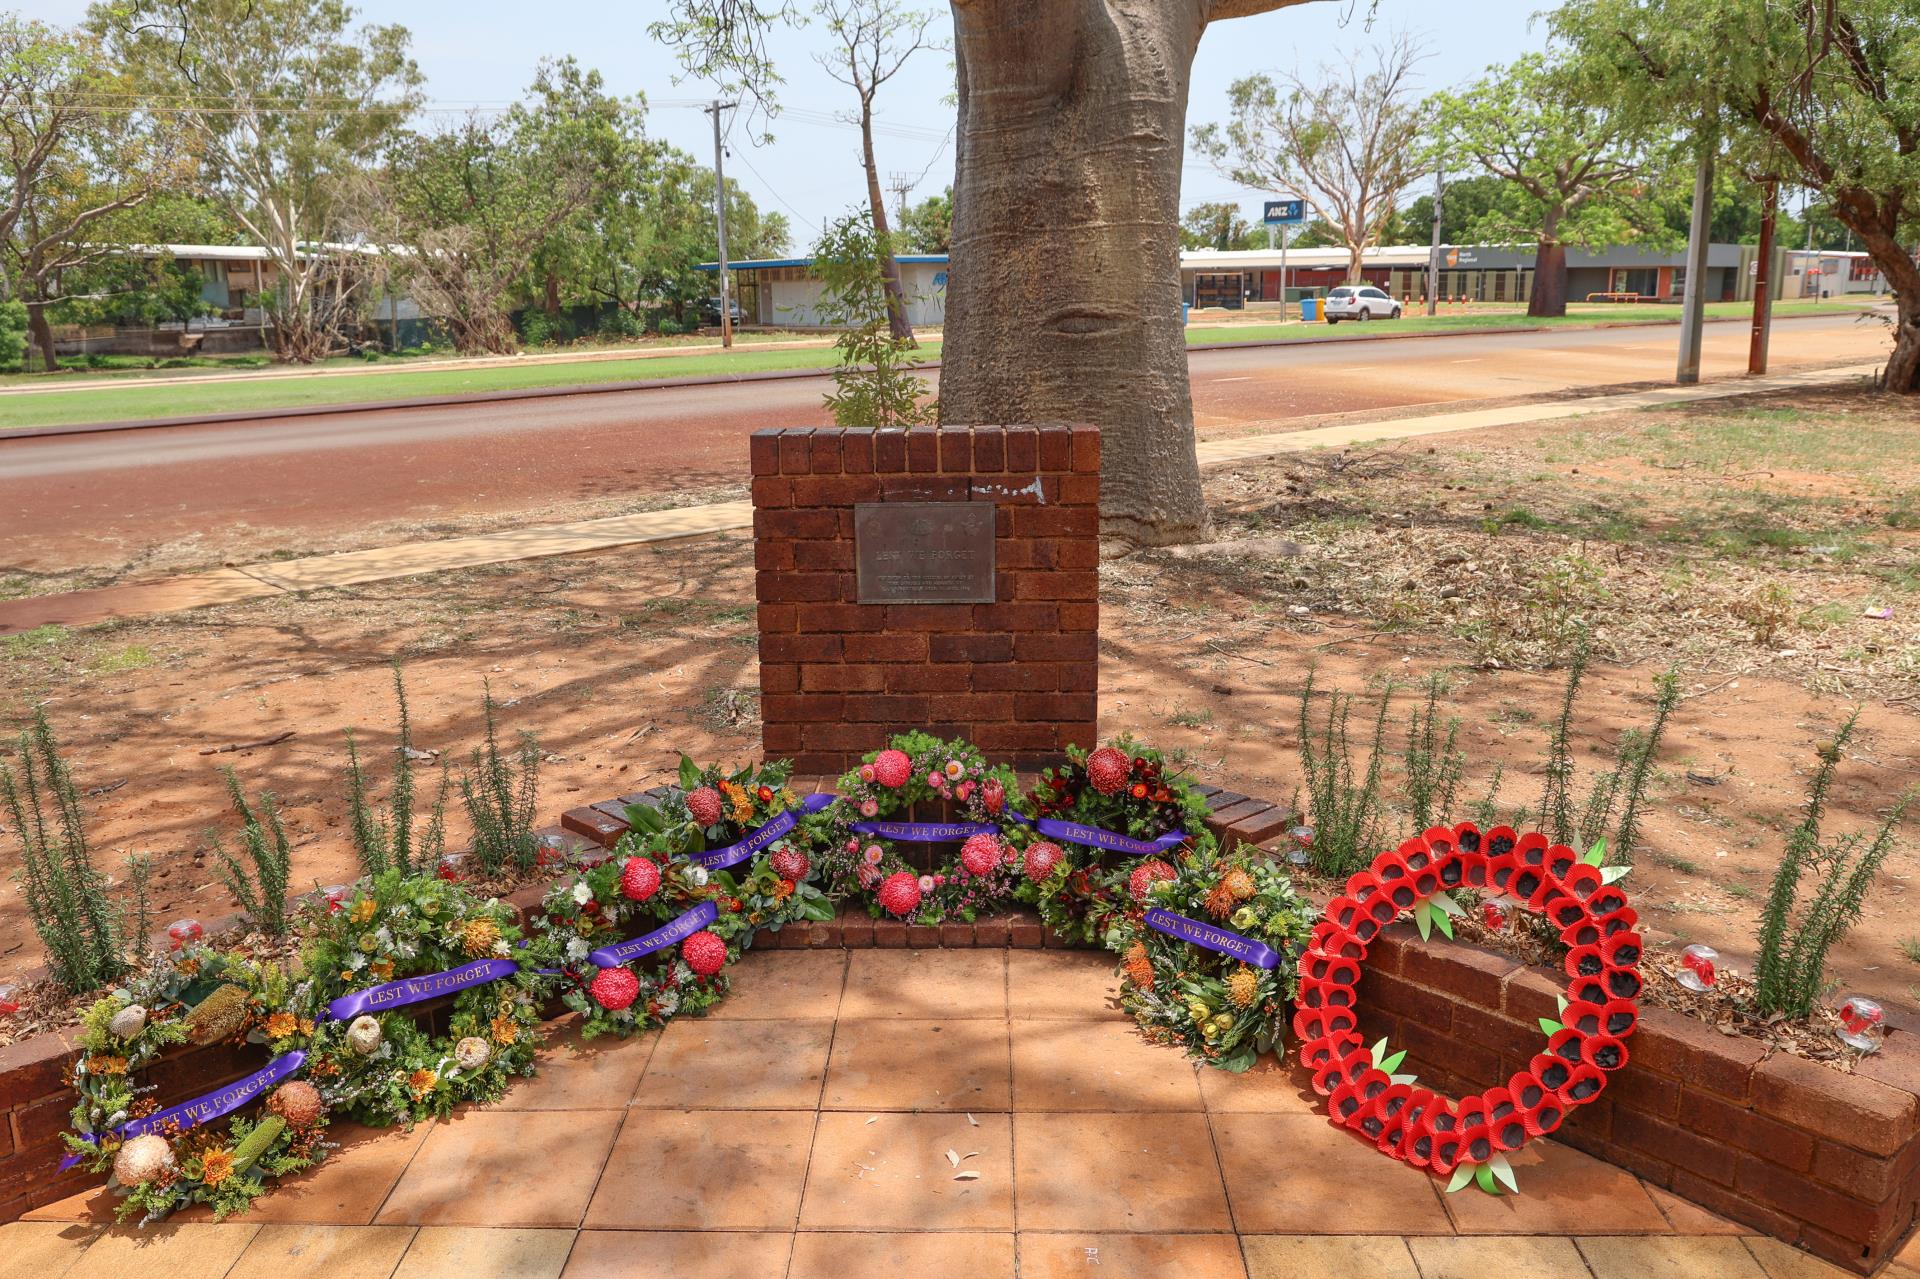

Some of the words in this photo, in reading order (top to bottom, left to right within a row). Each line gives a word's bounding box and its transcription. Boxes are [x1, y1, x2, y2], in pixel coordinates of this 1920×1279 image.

[1267, 206, 1288, 217] ANZ
[876, 550, 900, 561] LEST
[930, 550, 976, 560] FORGET
[703, 853, 726, 866] LEST
[730, 845, 748, 859] WE
[748, 816, 791, 849] FORGET
[879, 824, 906, 835] LEST
[911, 827, 929, 836] WE
[932, 826, 978, 836] FORGET
[1065, 827, 1095, 840] LEST
[1099, 833, 1117, 846] WE
[615, 943, 642, 957] LEST
[642, 936, 662, 949] WE
[661, 909, 708, 941] FORGET
[1151, 912, 1179, 930] LEST
[1183, 923, 1202, 938] WE
[1203, 930, 1252, 955] FORGET
[368, 986, 403, 1005] LEST
[407, 981, 433, 996] WE
[436, 963, 492, 990] FORGET
[184, 1100, 211, 1121] WE
[213, 1068, 277, 1109] FORGET
